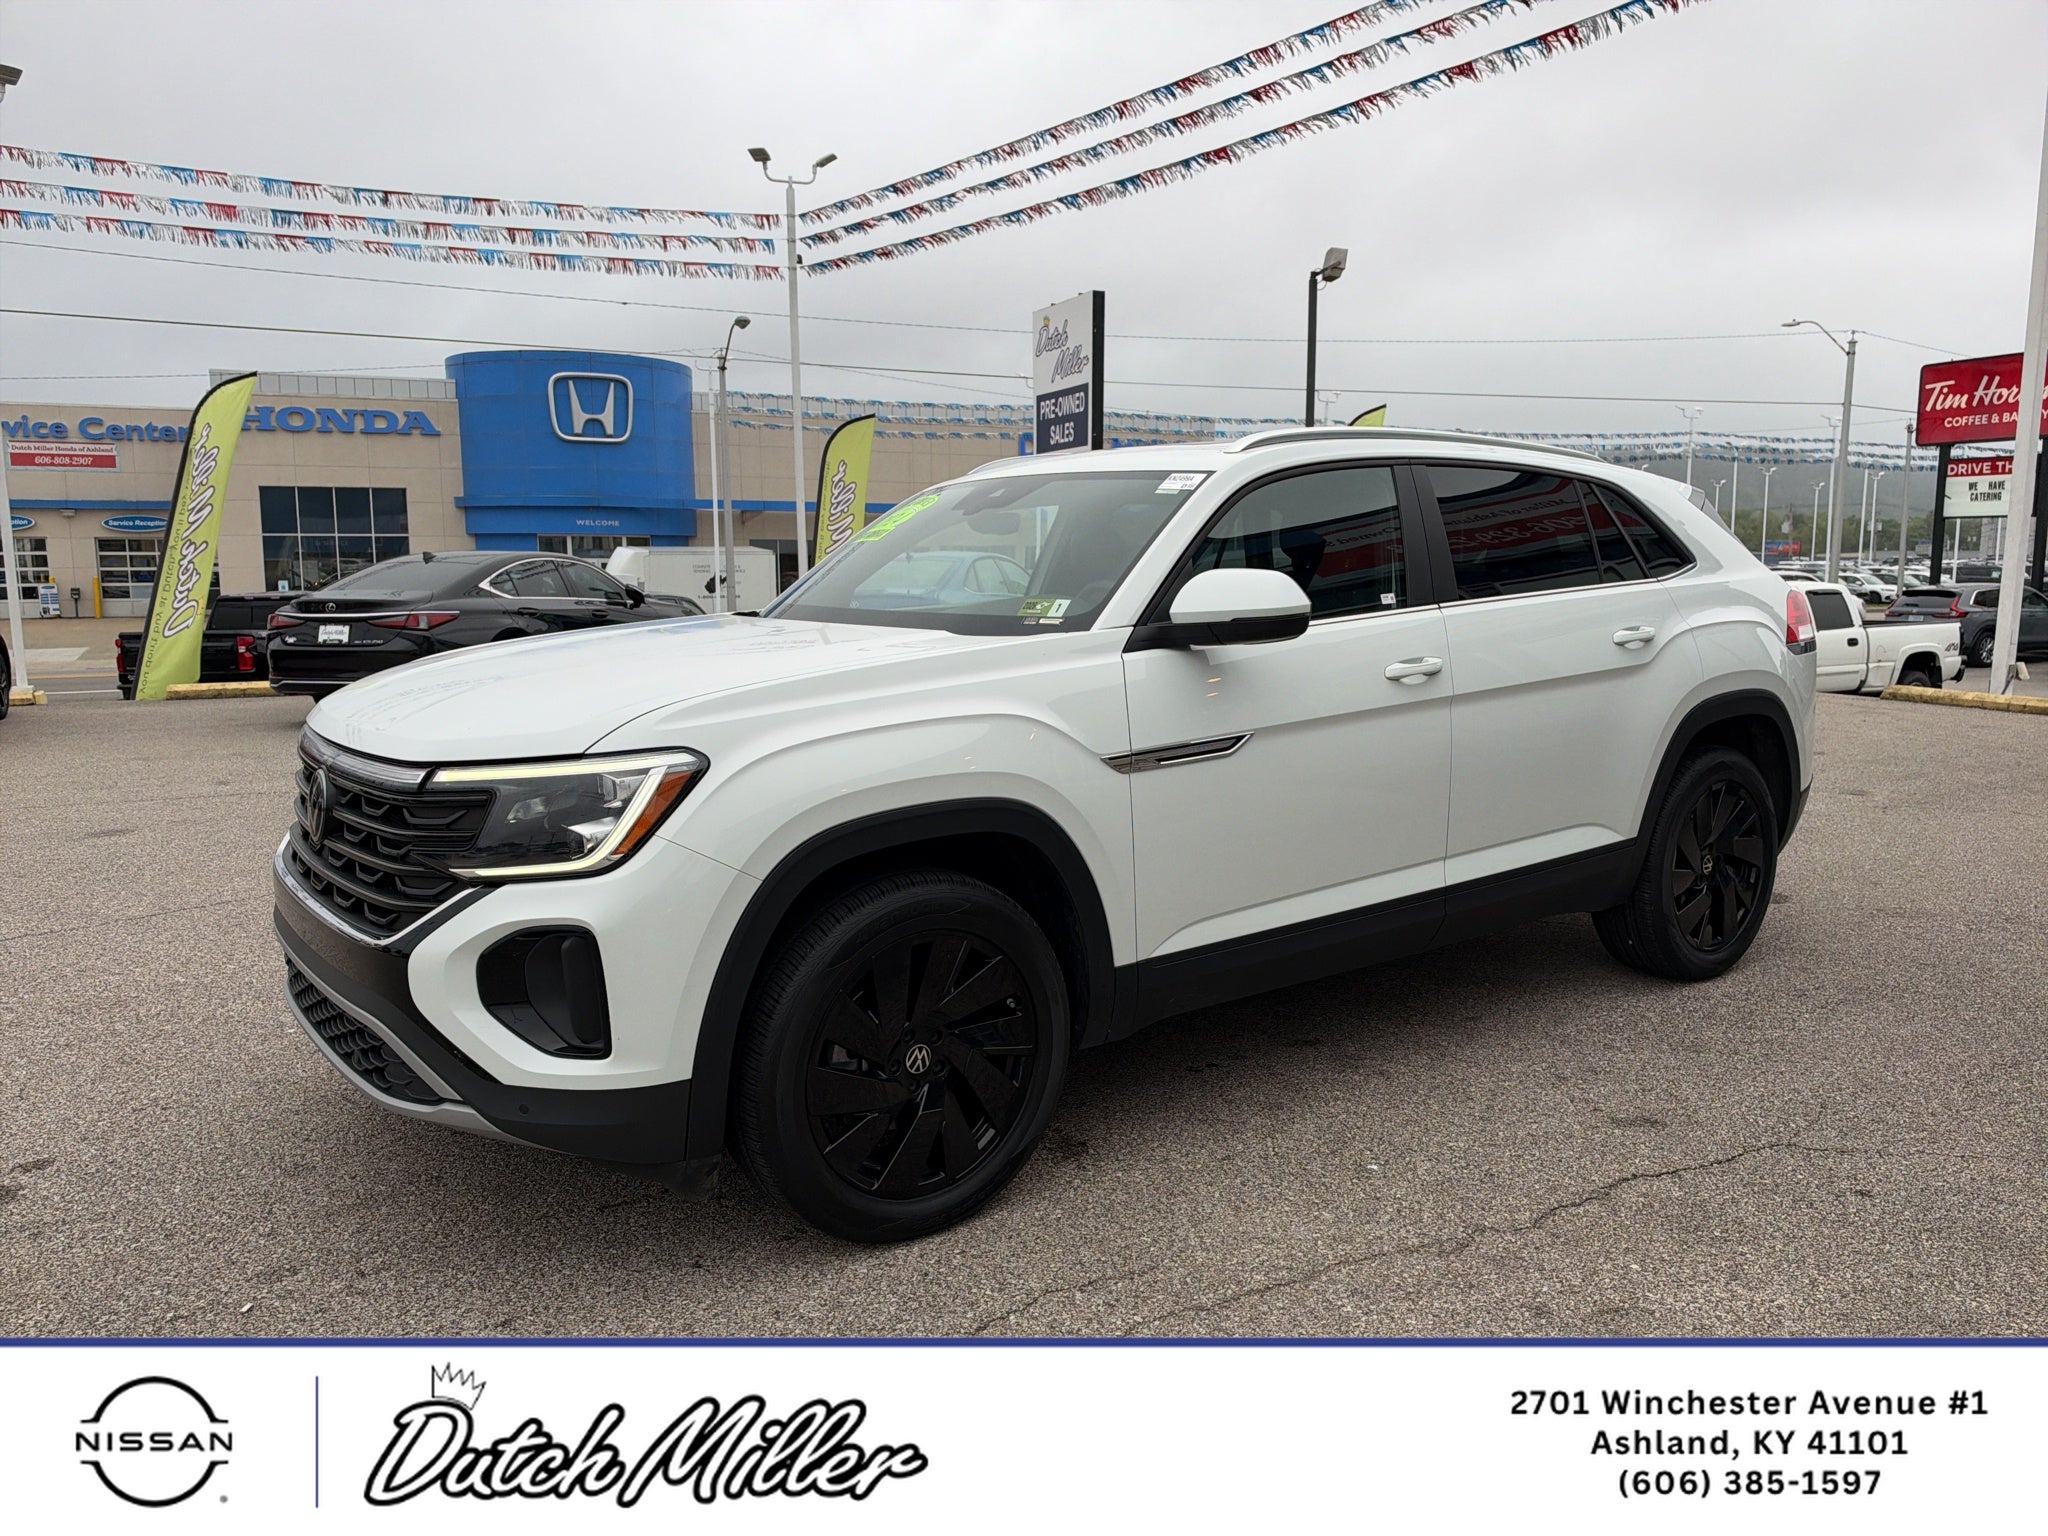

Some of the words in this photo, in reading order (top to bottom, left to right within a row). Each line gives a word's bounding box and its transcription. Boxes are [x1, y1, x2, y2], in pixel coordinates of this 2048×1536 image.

[1035, 319, 1069, 358] Dutch
[1051, 344, 1090, 384] Miller
[1040, 391, 1085, 421] PRE-OWNED
[1925, 379, 1968, 412] Tim
[1972, 375, 2048, 408] Hor
[78, 416, 190, 442] Center
[241, 405, 441, 435] HONDA
[1944, 414, 1988, 428] COFFEE
[1991, 413, 1999, 423] &
[1050, 421, 1075, 446] SALES
[34, 456, 93, 465] 606-808-2907
[1947, 462, 1992, 475] DRIVE
[1996, 461, 2013, 473] TH
[1968, 481, 1978, 491] WE
[1988, 481, 2006, 491] HAVE
[1970, 491, 2002, 502] CATERING
